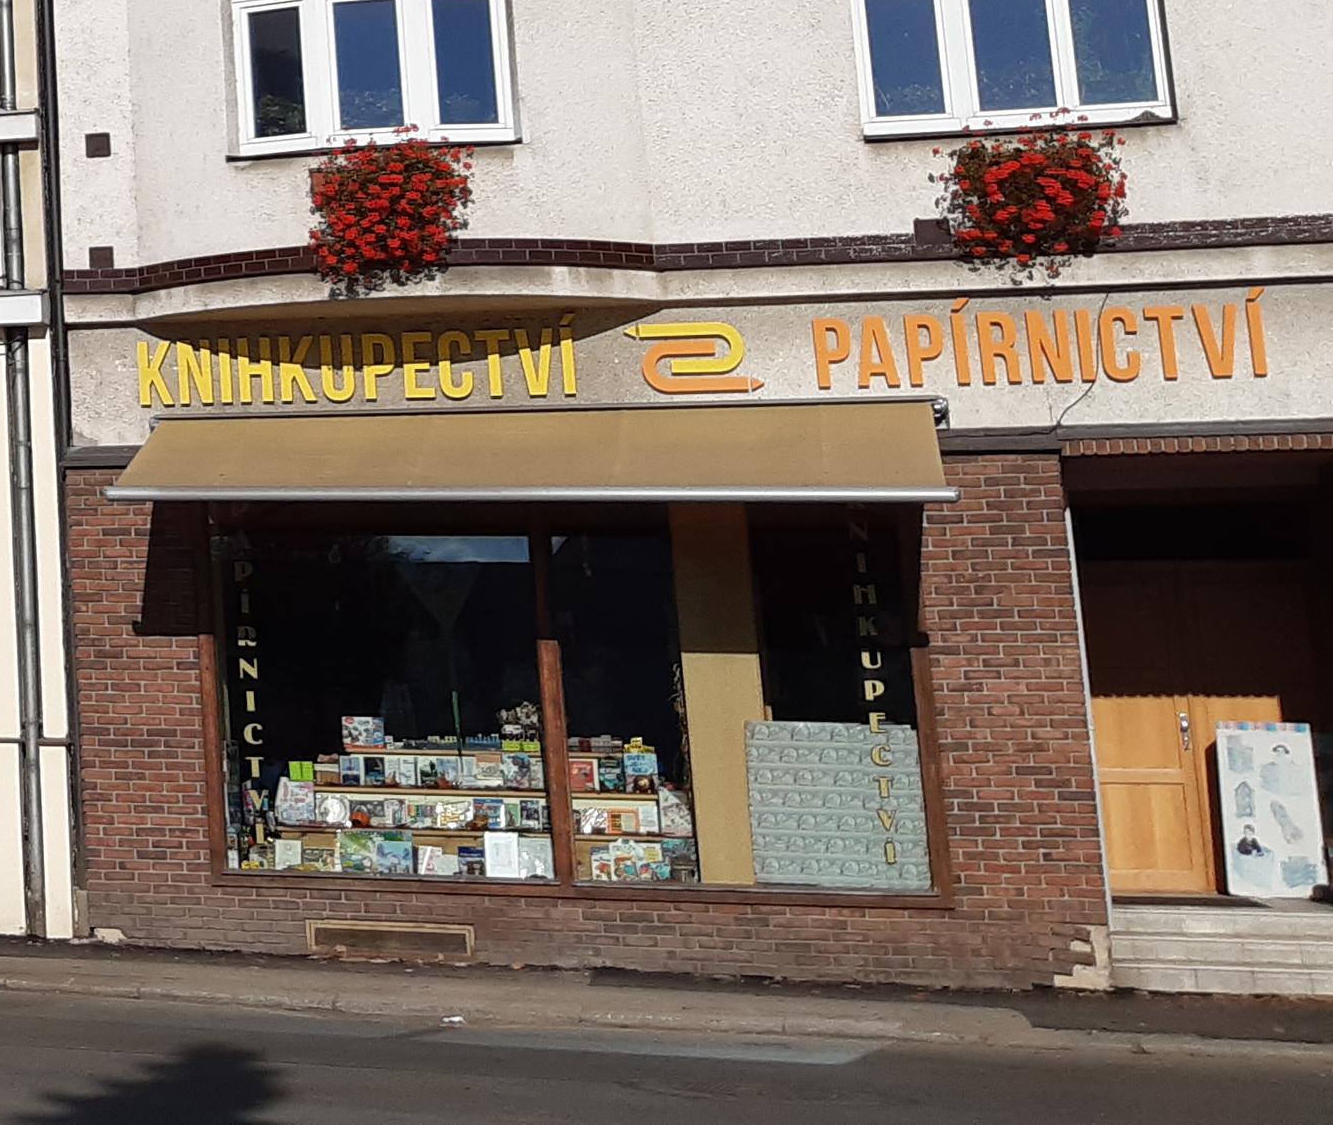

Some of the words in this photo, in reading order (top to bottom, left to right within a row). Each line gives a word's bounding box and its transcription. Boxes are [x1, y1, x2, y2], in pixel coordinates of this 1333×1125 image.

[136, 312, 578, 407] KNIHKUPECTVÍ
[812, 287, 1268, 390] PAPÍRNICTVÍ
[847, 502, 897, 865] NIHKUPECTVÍ
